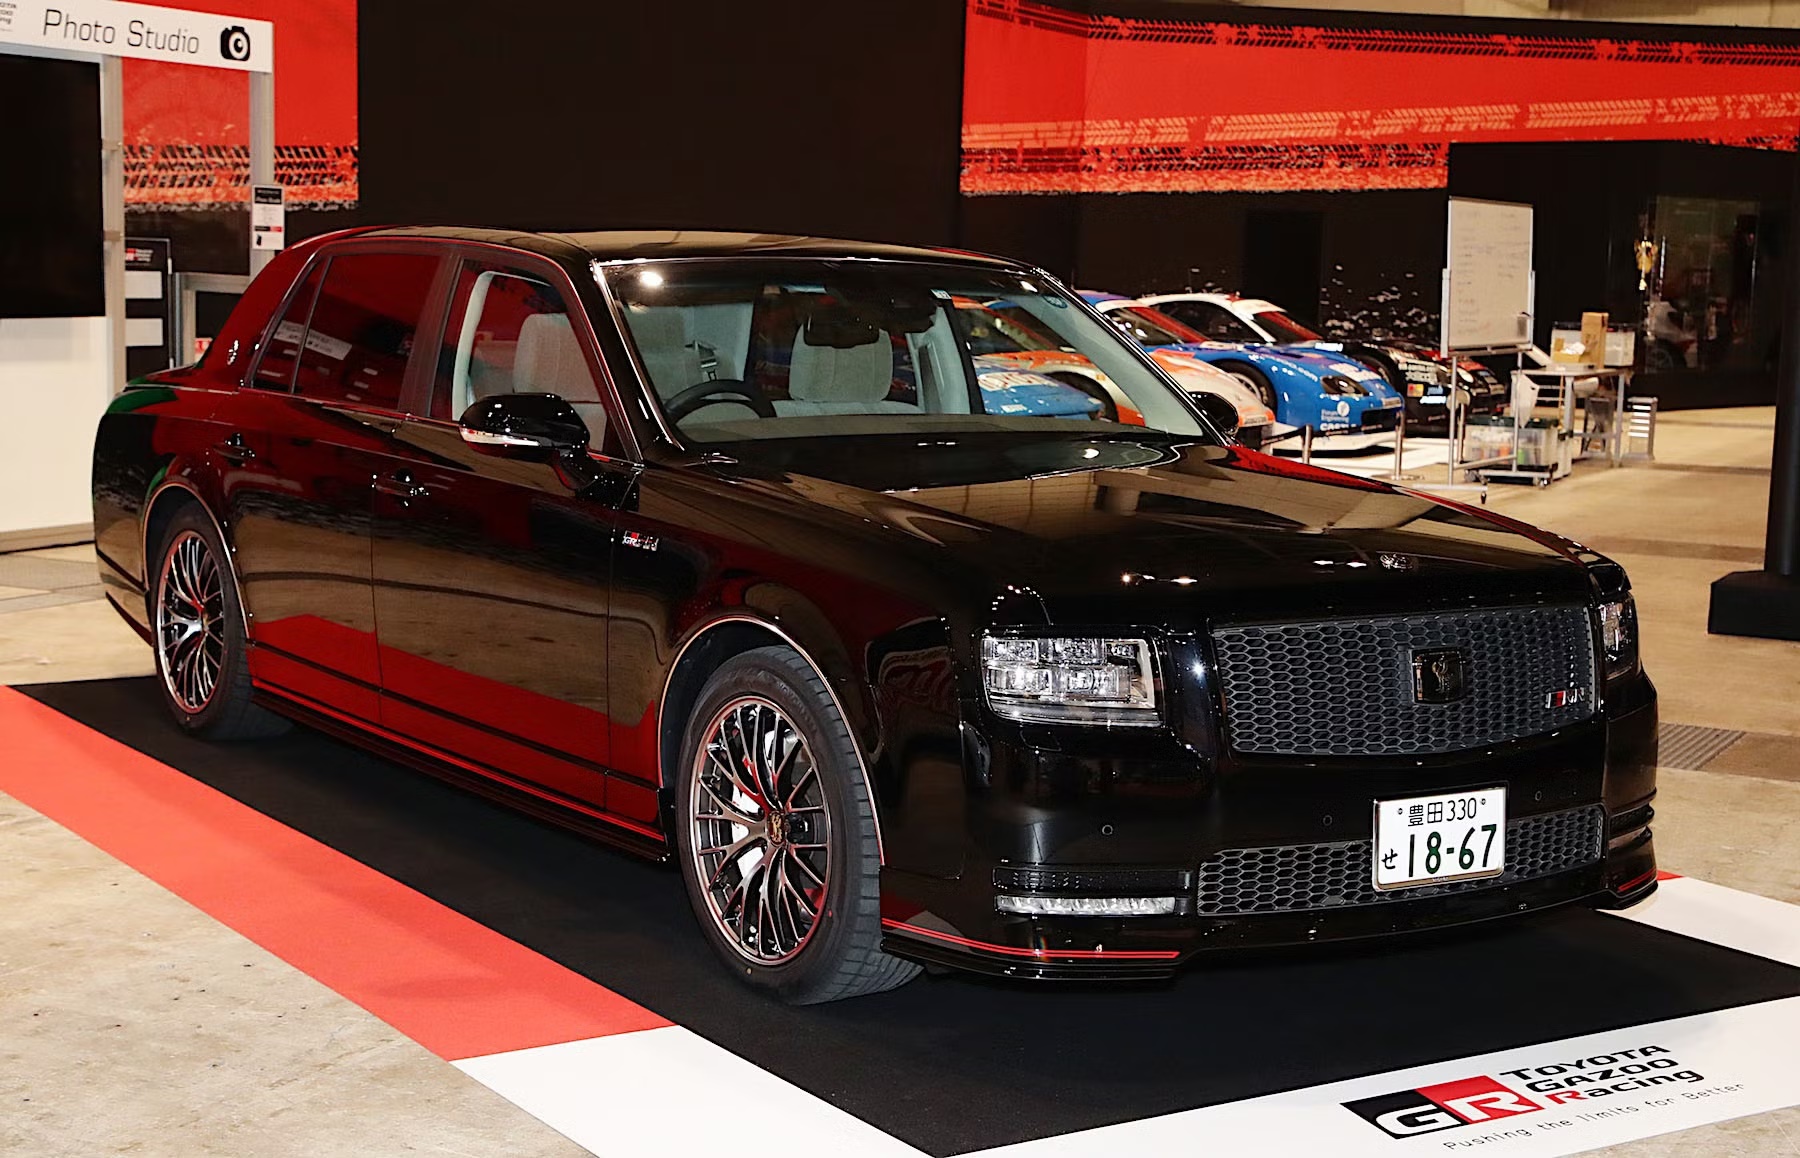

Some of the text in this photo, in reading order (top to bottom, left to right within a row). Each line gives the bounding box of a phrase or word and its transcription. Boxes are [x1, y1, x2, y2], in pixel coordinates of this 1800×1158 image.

[43, 8, 116, 44] Photo
[127, 19, 200, 54] Studio
[1381, 823, 1497, 878] せ 18-67
[1499, 1045, 1672, 1081] TOYOTA
[1524, 1058, 1680, 1093] GAZOO
[1543, 1070, 1705, 1105] Racing
[1374, 1089, 1540, 1136] GR
[1443, 1082, 1744, 1150] Pushing the limits for Better
